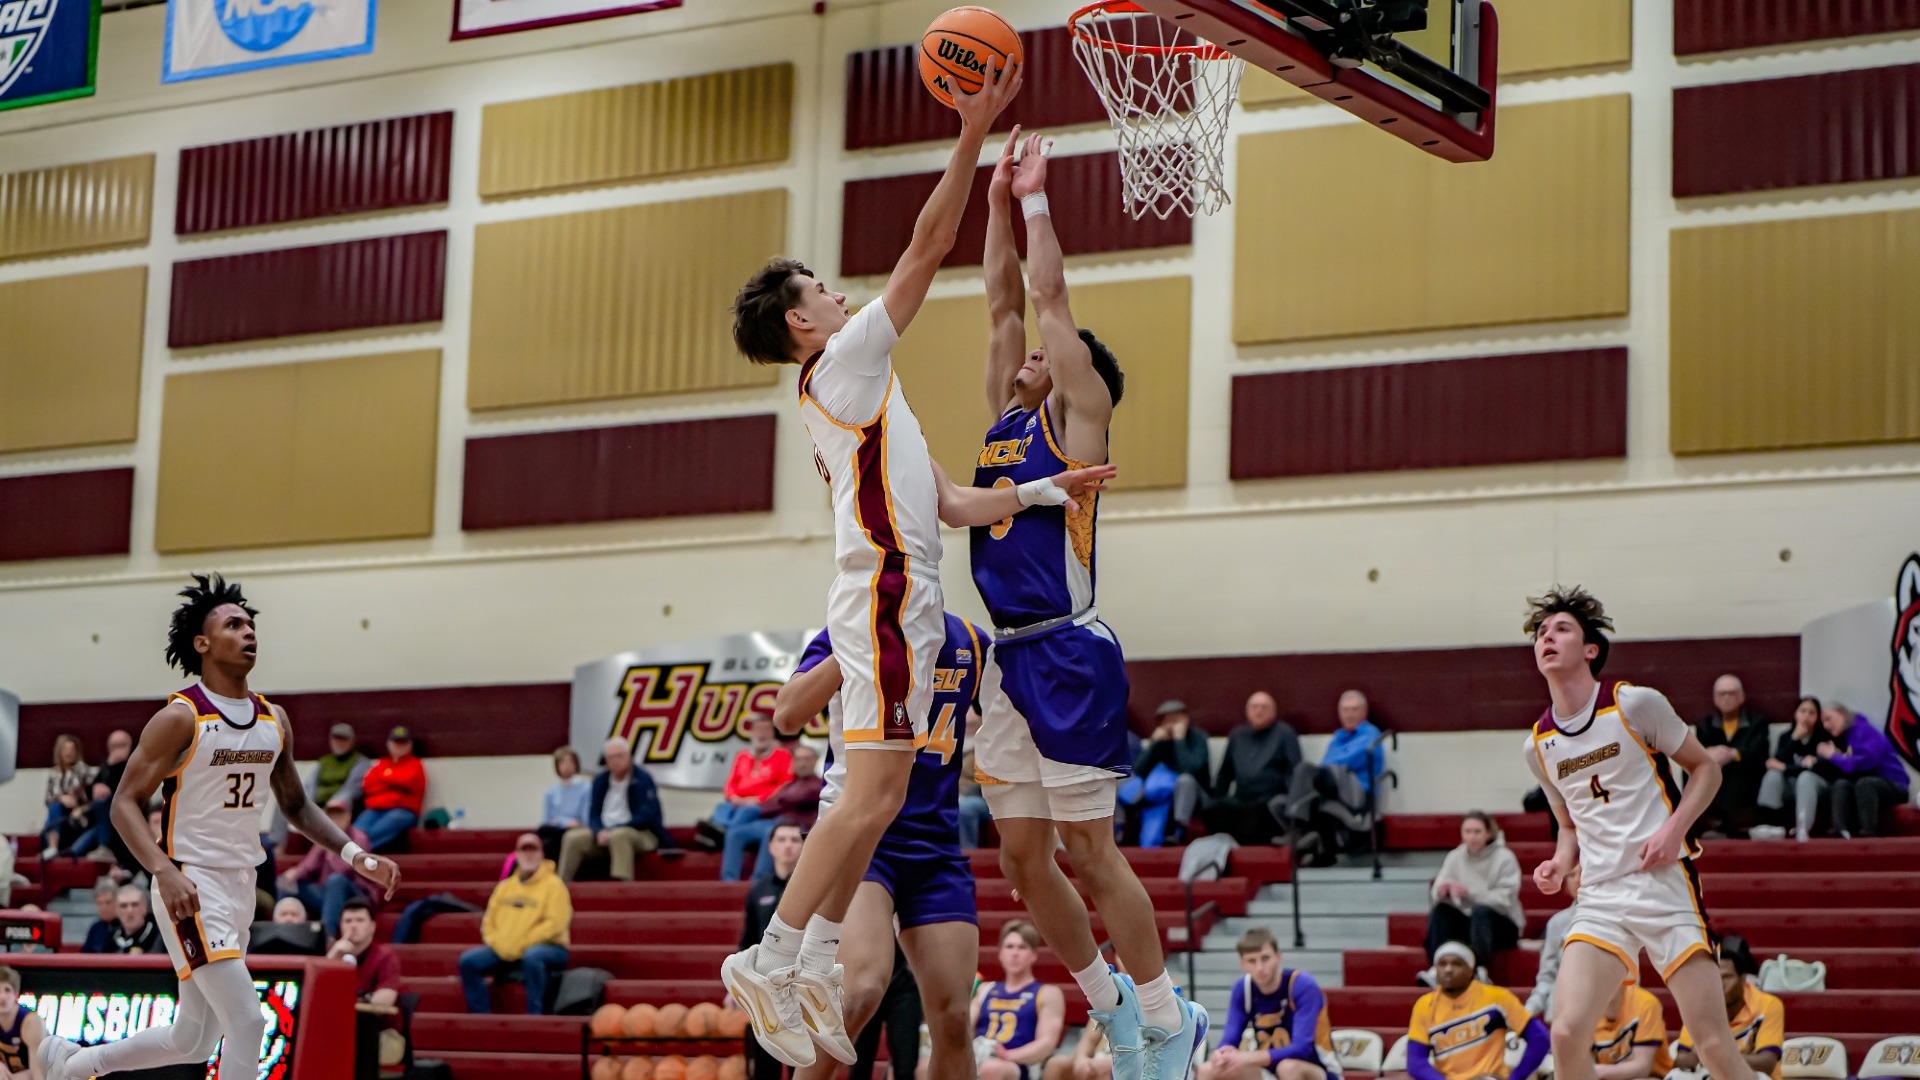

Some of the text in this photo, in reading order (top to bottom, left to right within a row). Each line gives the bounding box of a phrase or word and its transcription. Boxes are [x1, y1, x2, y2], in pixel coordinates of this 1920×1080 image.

[0, 0, 49, 33] AC
[922, 702, 958, 766] 4
[209, 748, 275, 767] HUSKIES
[1556, 741, 1621, 780] HUSKIES
[223, 773, 256, 808] 32
[1589, 774, 1612, 804] 4
